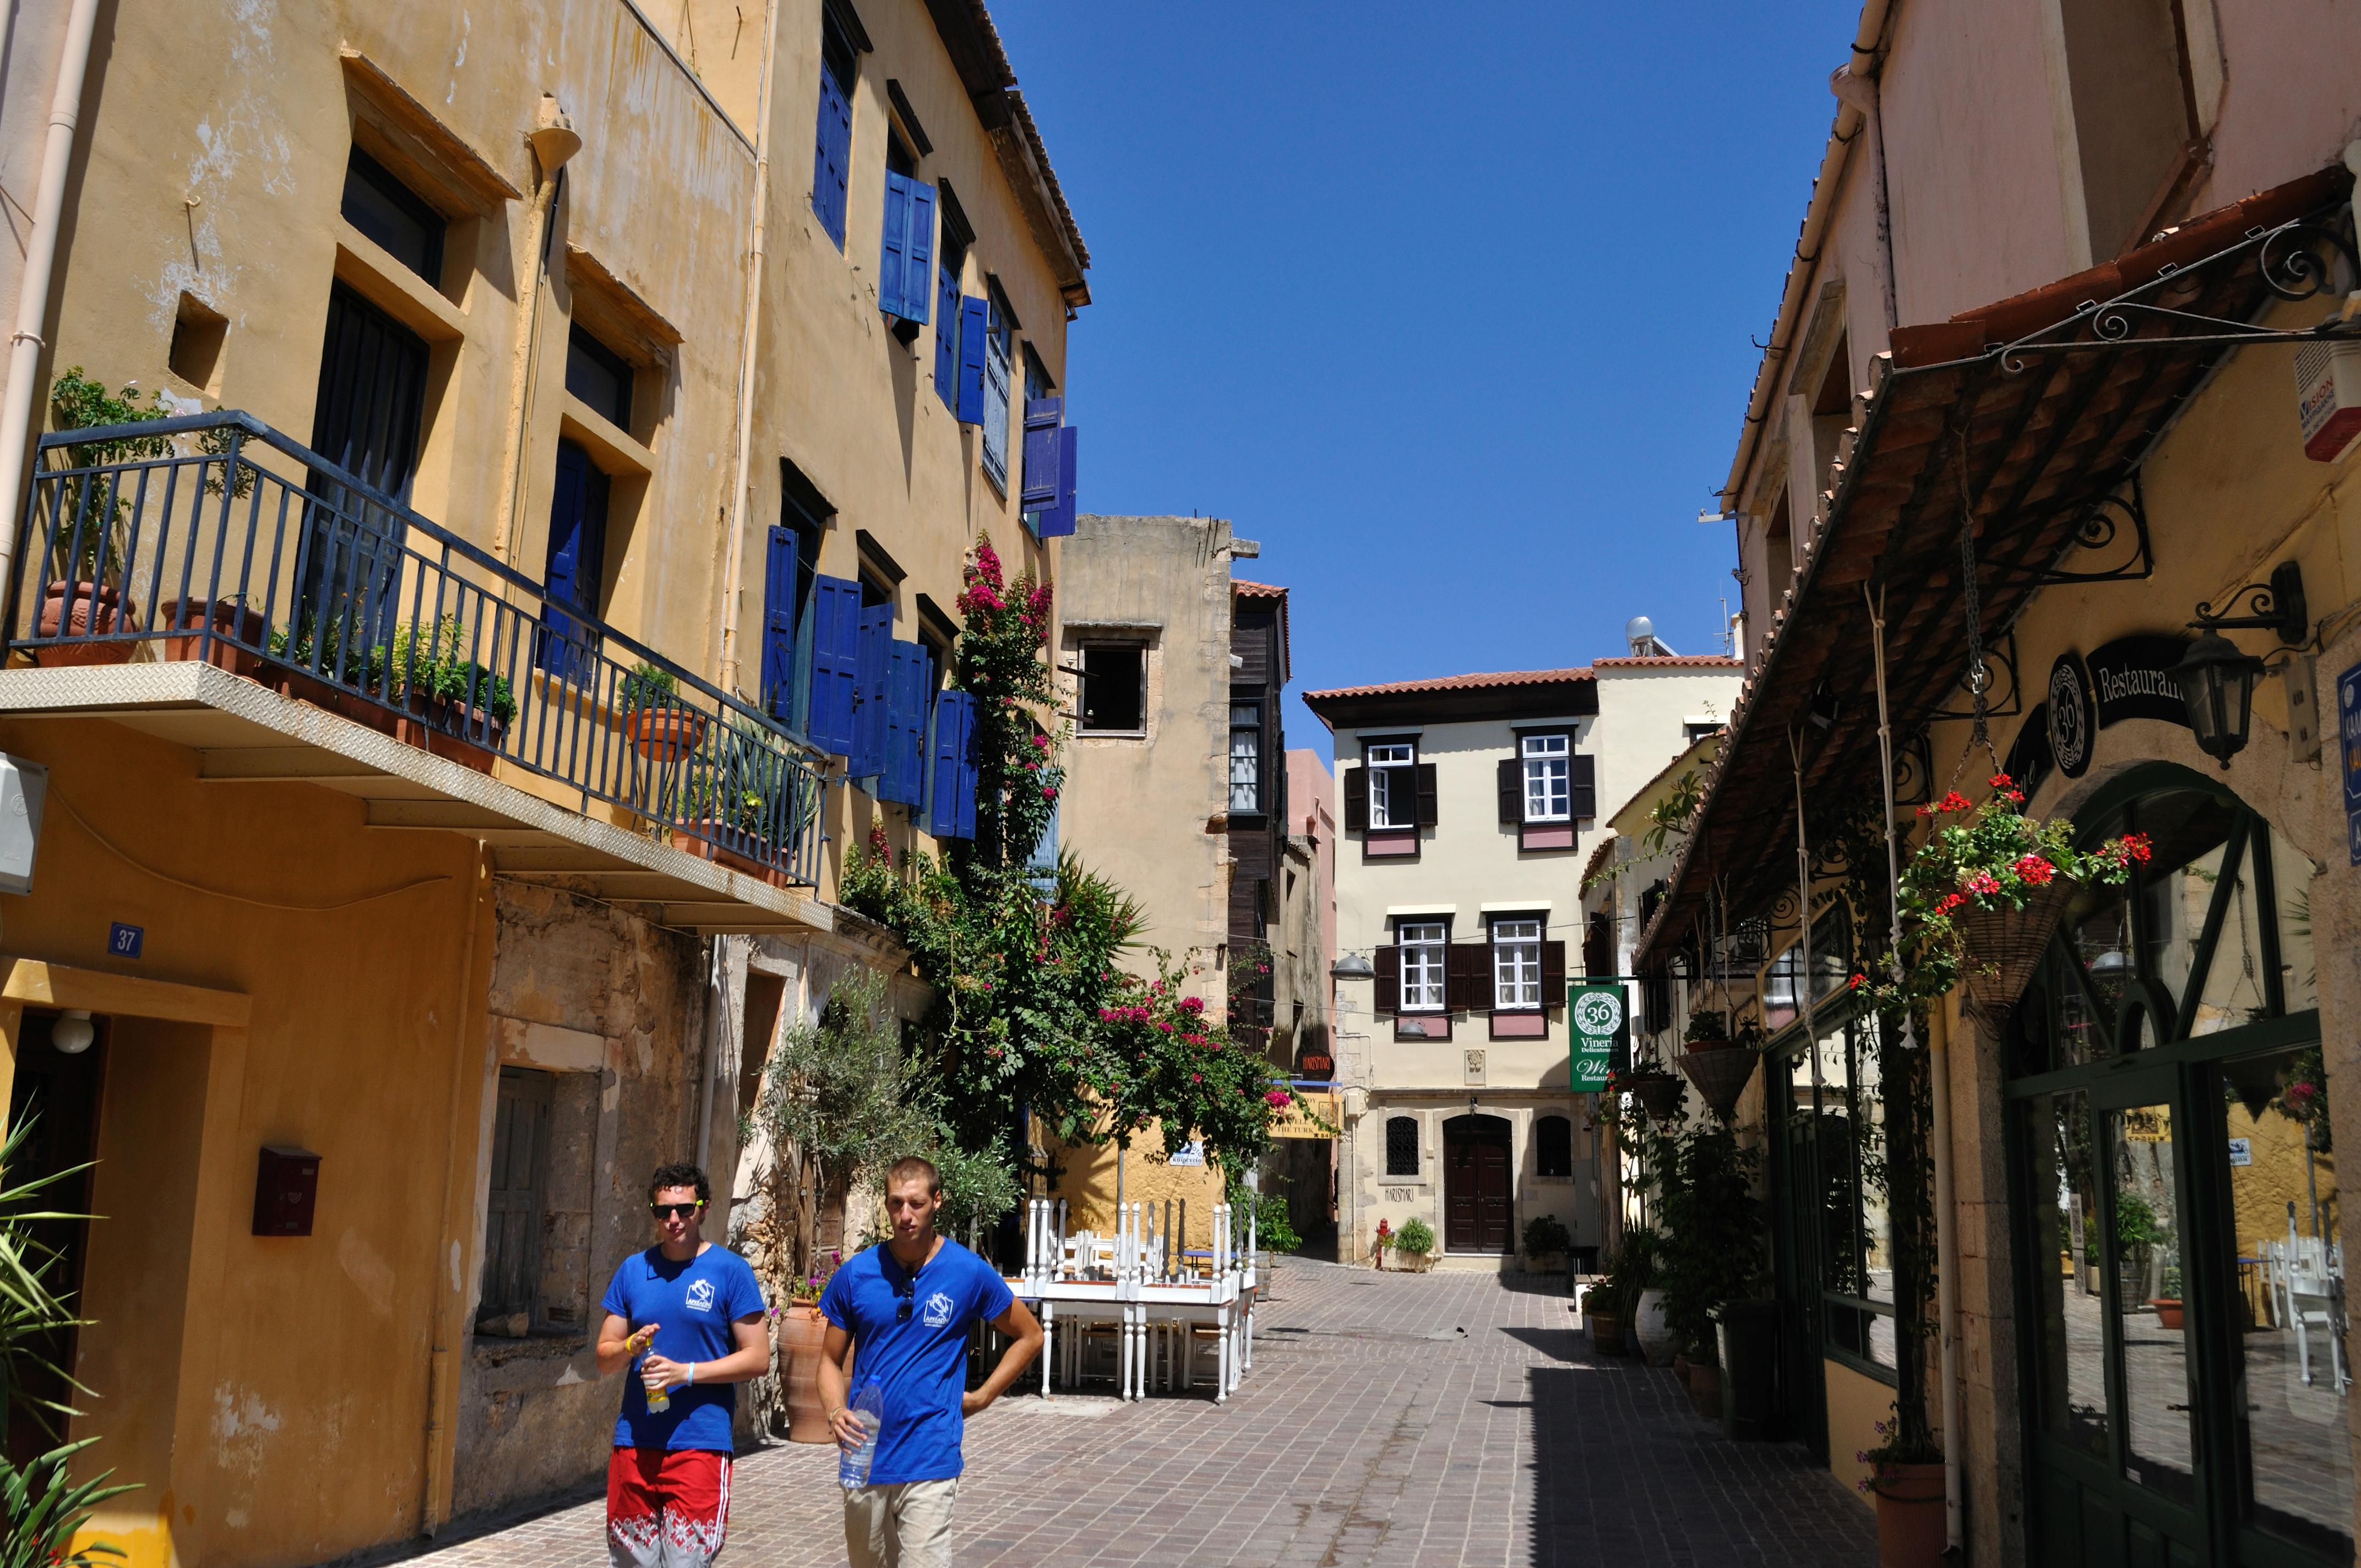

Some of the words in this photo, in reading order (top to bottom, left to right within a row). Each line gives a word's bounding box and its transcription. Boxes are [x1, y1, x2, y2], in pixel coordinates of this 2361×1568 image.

[2299, 375, 2333, 420] VISION
[2058, 688, 2075, 743] 36
[117, 929, 135, 951] 37
[1587, 1004, 1609, 1024] 36
[1581, 1037, 1619, 1047] Vineria
[1303, 1057, 1330, 1070] HARISMARI
[1576, 1058, 1625, 1075] Wine
[1385, 1187, 1414, 1202] HARISMARI
